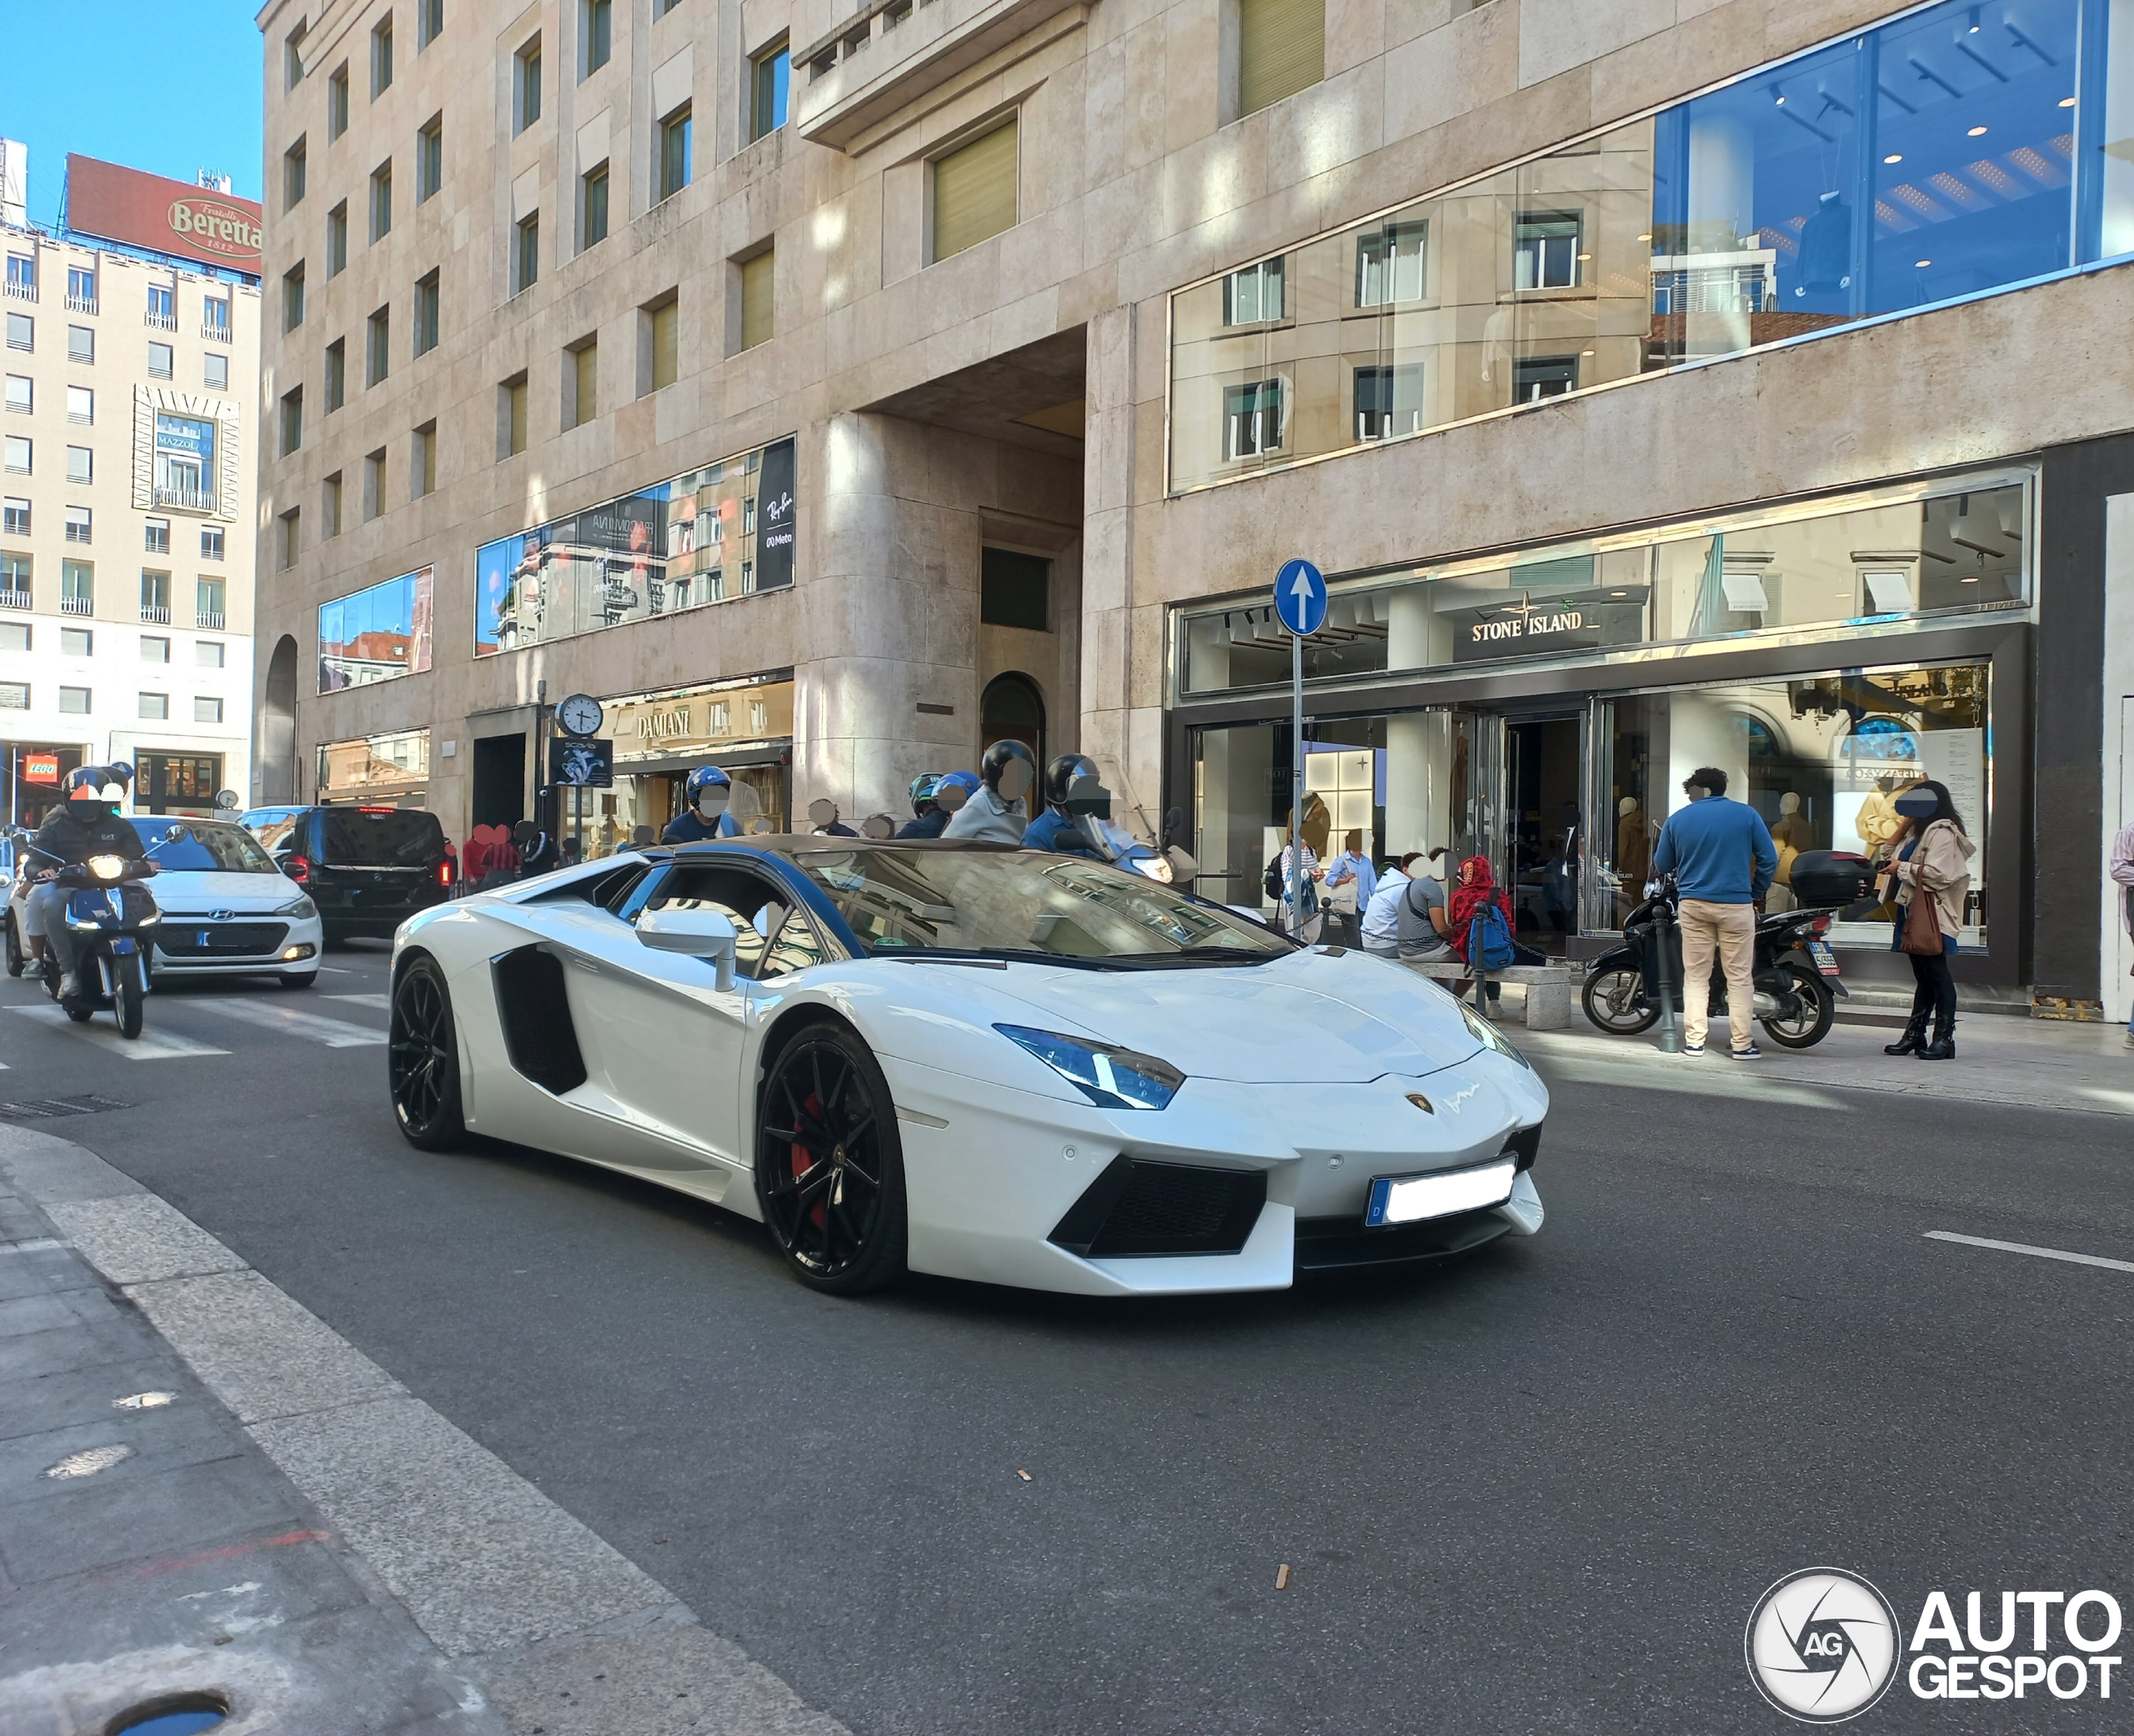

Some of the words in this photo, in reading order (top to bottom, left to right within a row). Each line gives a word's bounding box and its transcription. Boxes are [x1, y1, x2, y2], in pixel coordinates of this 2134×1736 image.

[200, 203, 238, 220] Fratelli
[173, 203, 263, 250] Beretta
[207, 240, 234, 253] 1812
[158, 436, 211, 452] MAZZOLARI
[774, 533, 793, 547] Meta
[1472, 619, 1522, 642] STONE
[1528, 612, 1583, 635] ISLAND
[638, 711, 689, 740] DAMIANI
[28, 763, 57, 773] LEGO
[1373, 1207, 1380, 1217] D
